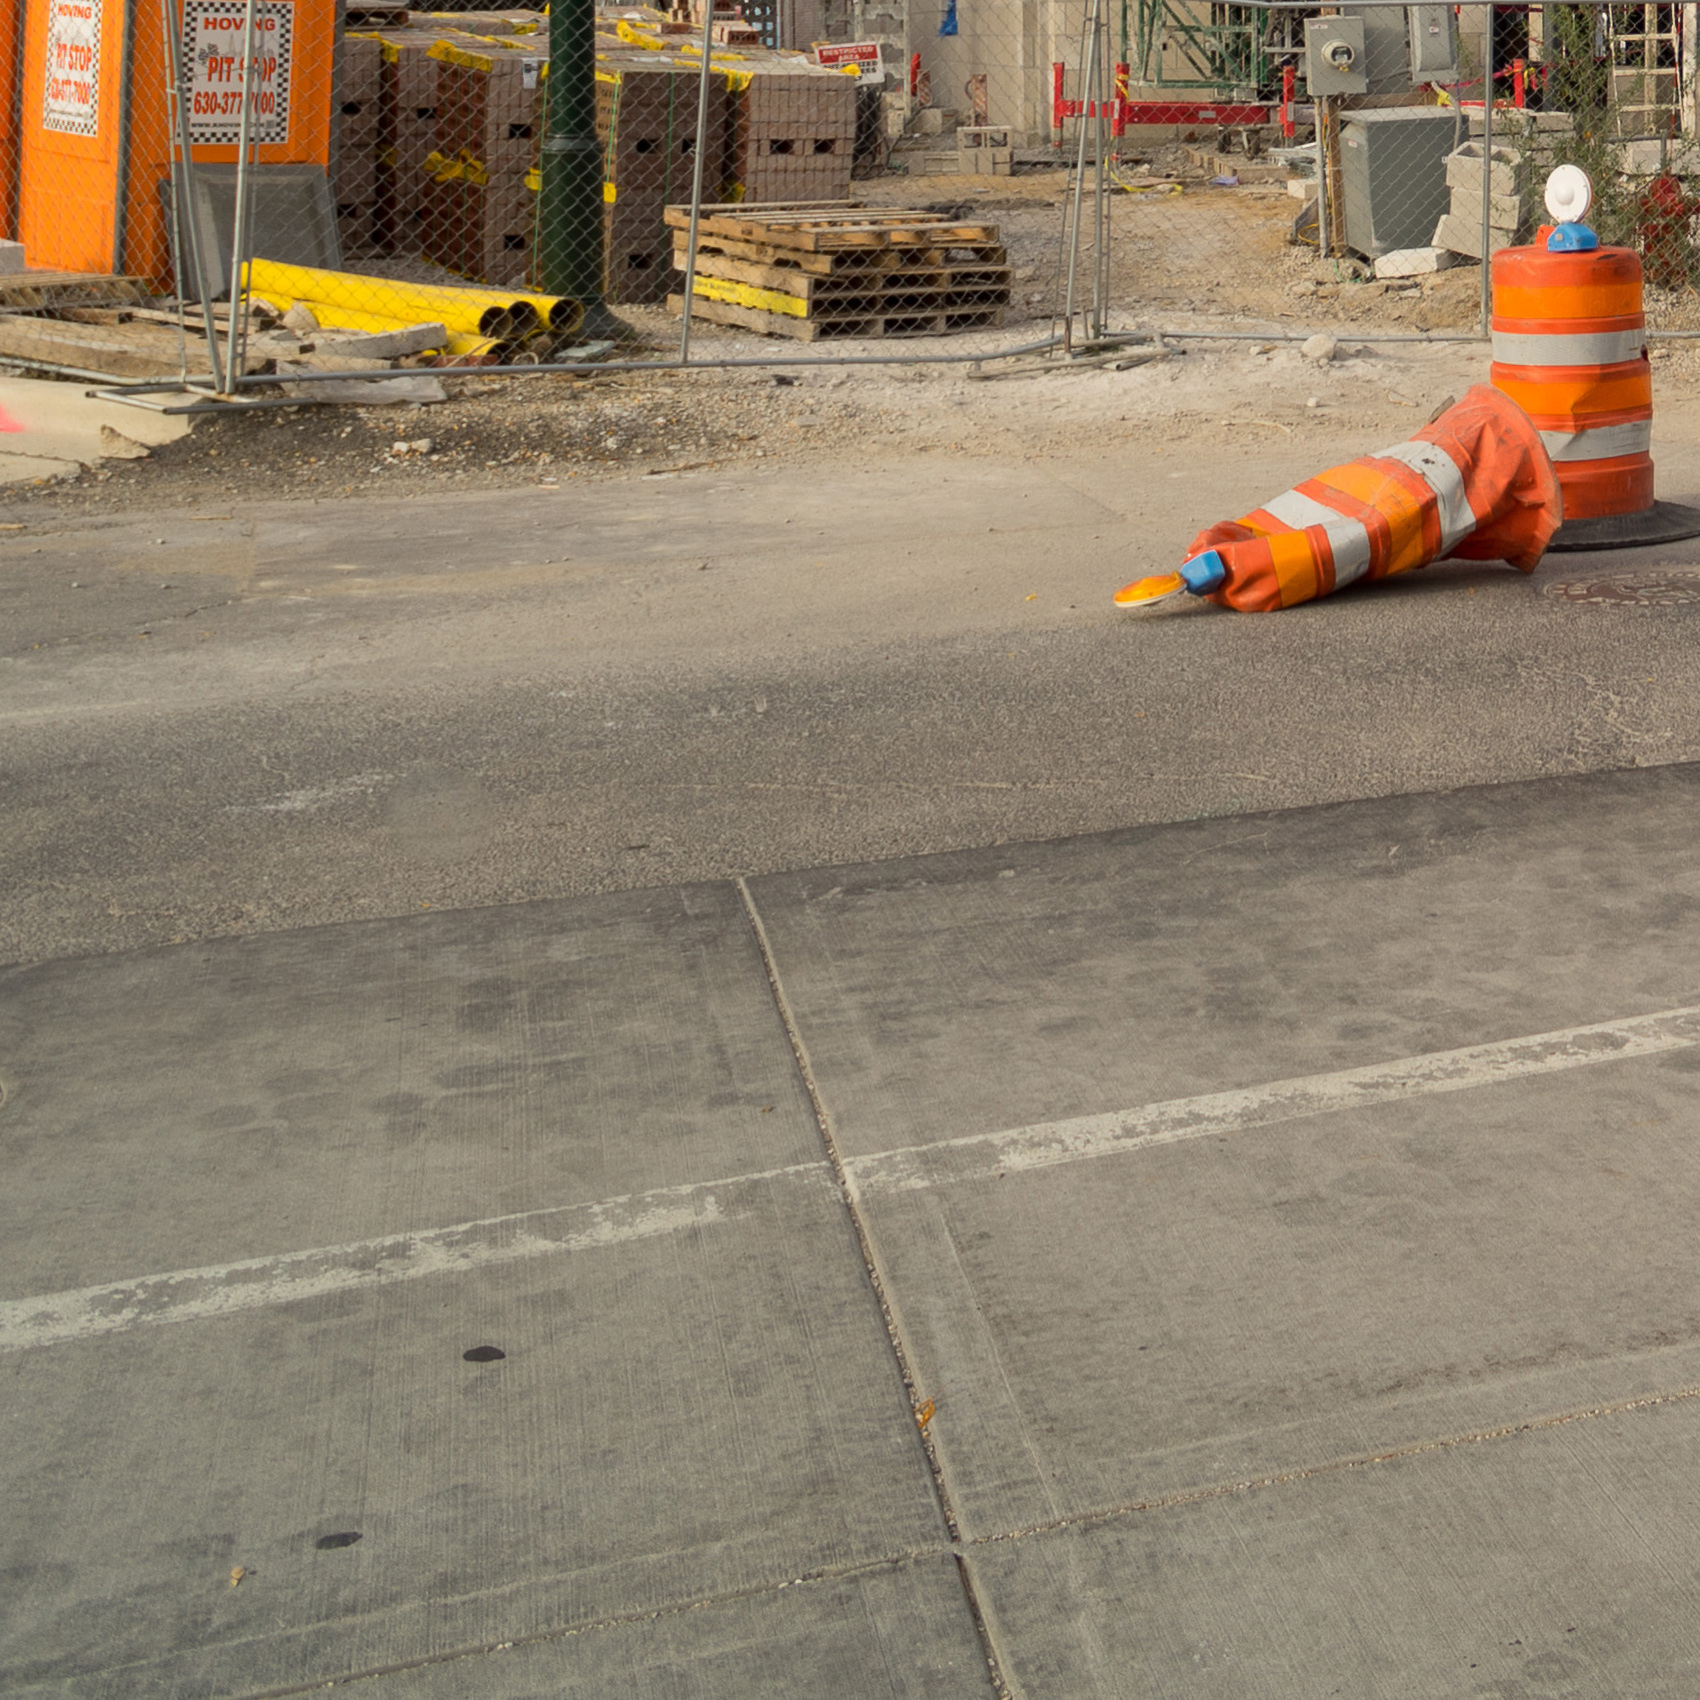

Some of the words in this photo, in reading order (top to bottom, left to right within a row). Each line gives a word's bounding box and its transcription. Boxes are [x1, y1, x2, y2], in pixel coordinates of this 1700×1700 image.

[57, 3, 92, 19] HOVING
[203, 17, 276, 31] HOVNG
[68, 46, 92, 71] STOP
[207, 56, 235, 82] PIT
